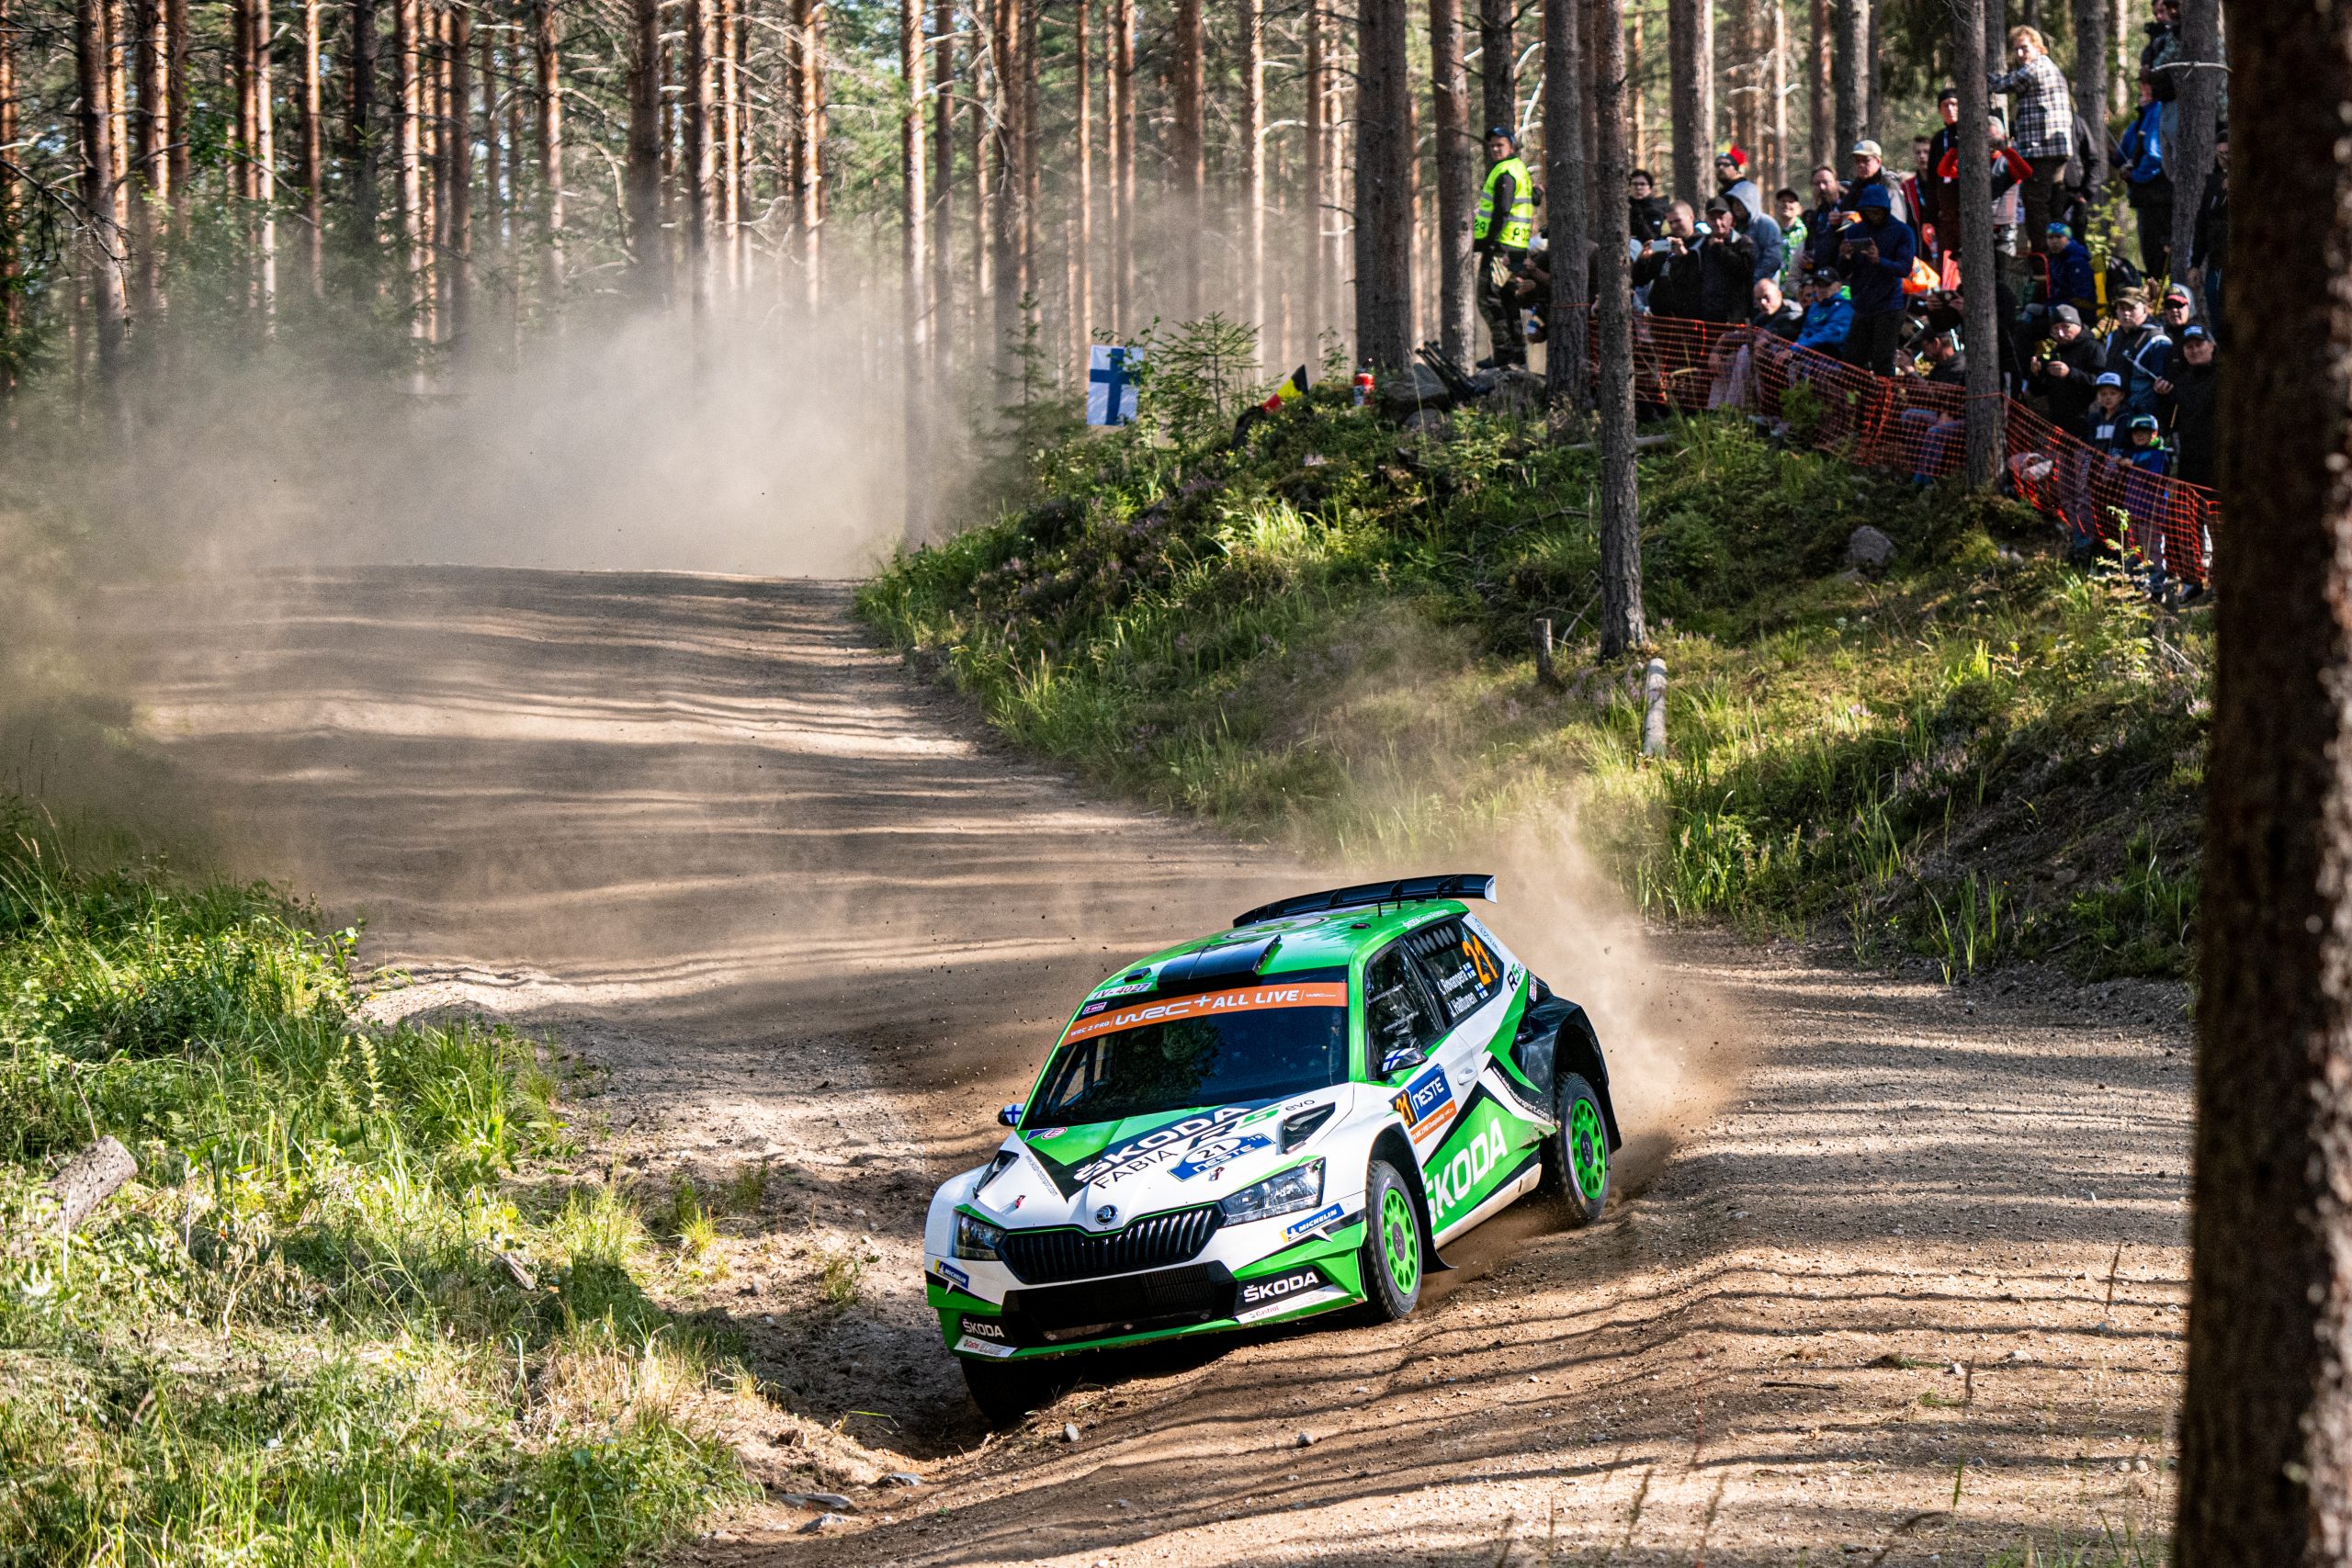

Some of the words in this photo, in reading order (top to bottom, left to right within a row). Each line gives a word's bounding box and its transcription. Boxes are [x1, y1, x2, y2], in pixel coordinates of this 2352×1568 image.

[1463, 935, 1498, 986] 21
[1094, 1021, 1110, 1030] PRO
[1212, 995, 1249, 1009] ALL
[1255, 989, 1299, 1004] LIVE
[1285, 1099, 1315, 1111] evo
[1073, 1107, 1251, 1182] ŠKODA
[1197, 1143, 1227, 1159] 21
[1093, 1149, 1179, 1190] FABIA
[1298, 1209, 1337, 1232] MICHELIN
[944, 1269, 967, 1283] MICHELIN
[1243, 1271, 1319, 1303] ŠKODA
[1255, 1304, 1280, 1318] Castrol
[962, 1318, 1005, 1338] ŠKODA
